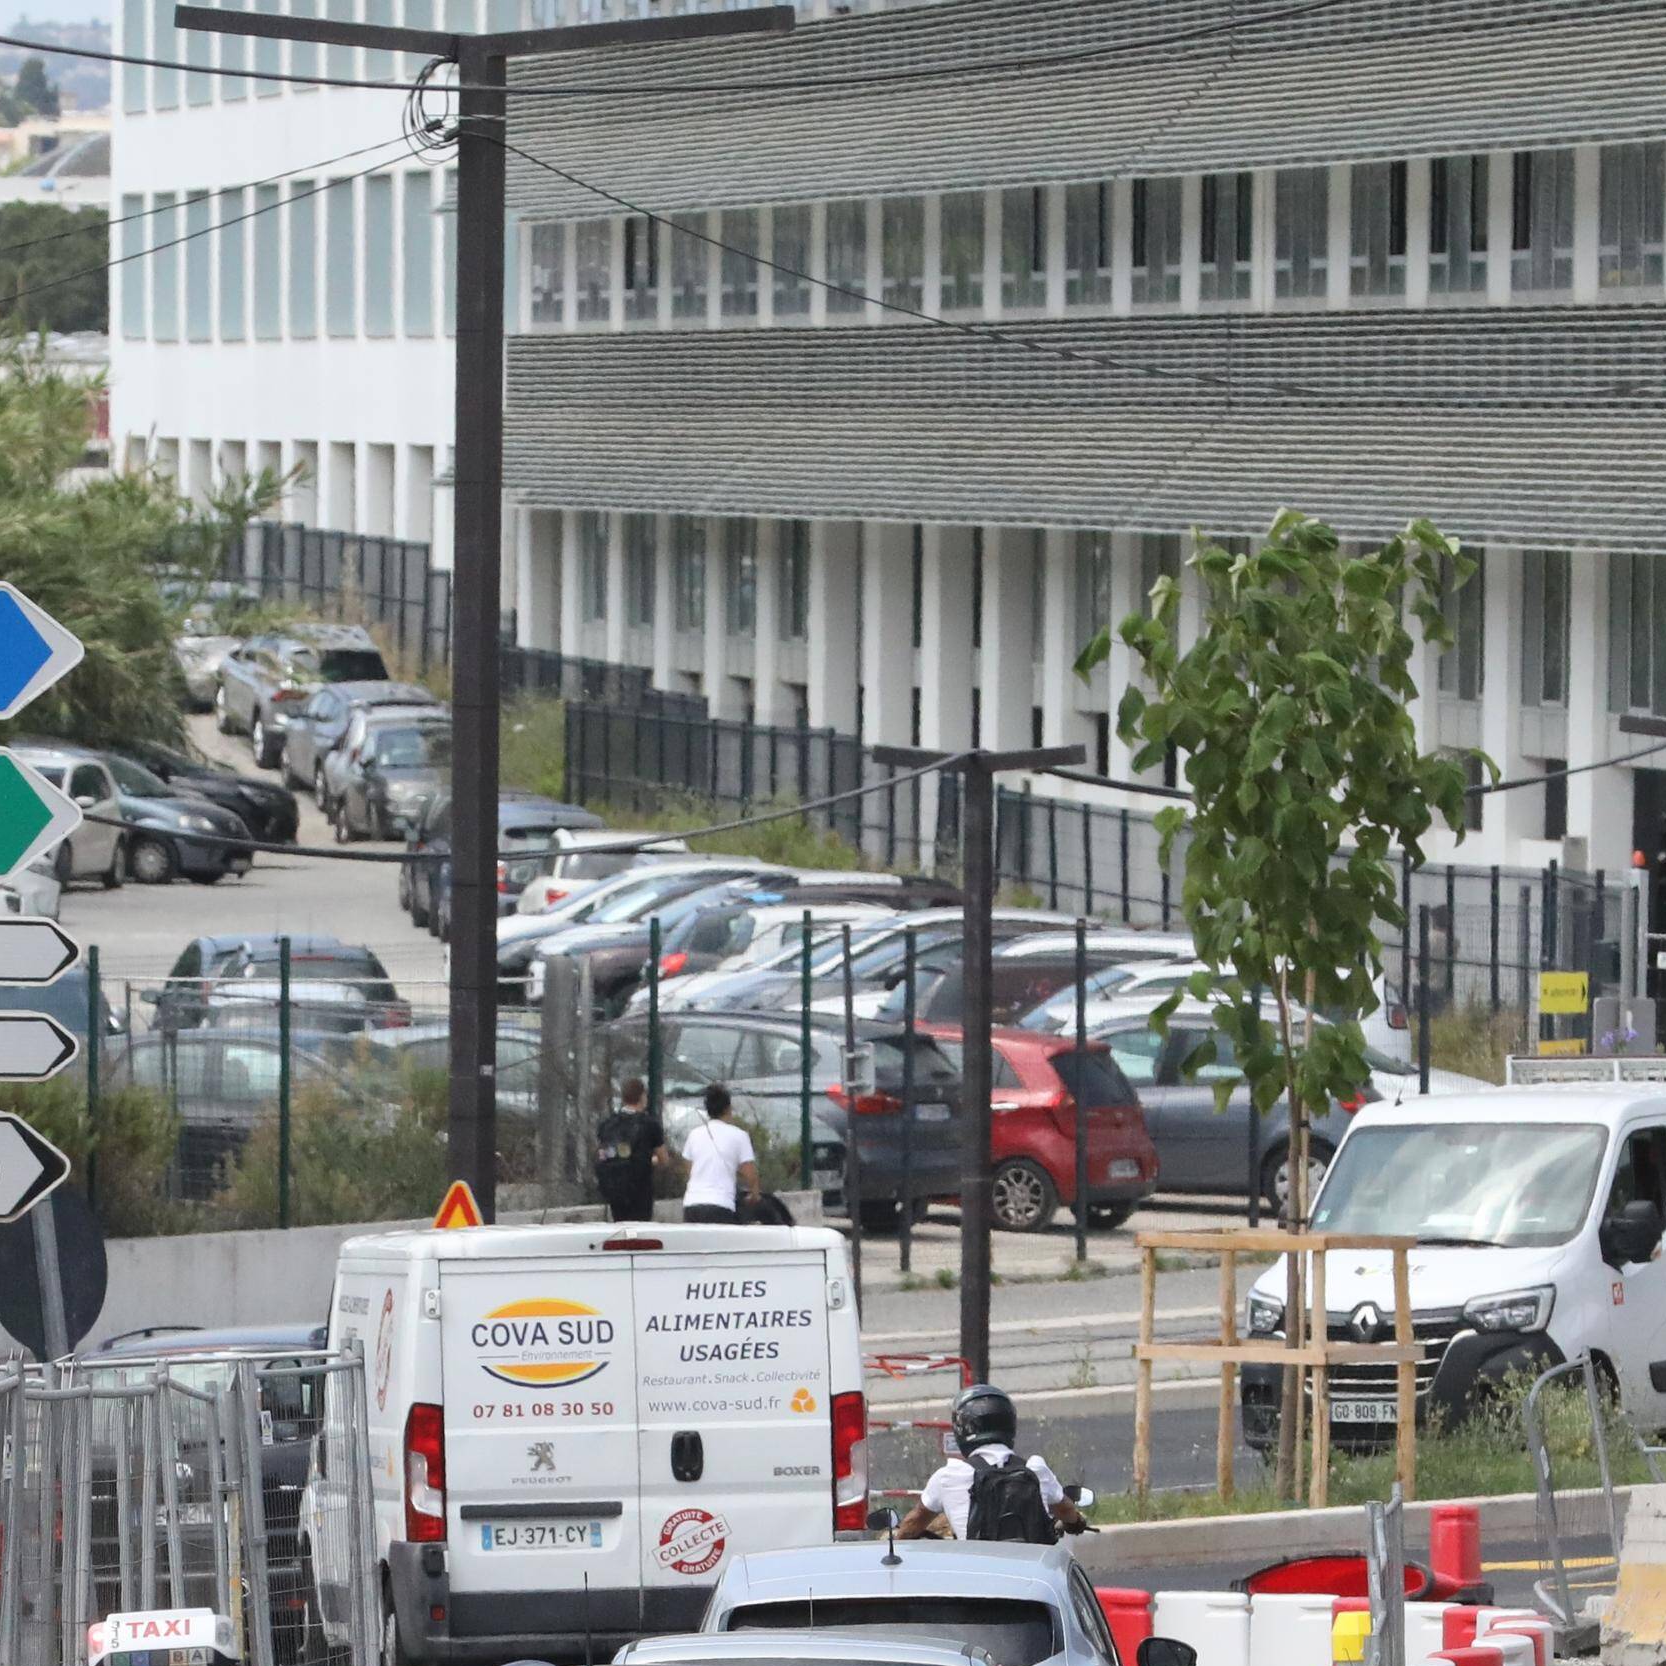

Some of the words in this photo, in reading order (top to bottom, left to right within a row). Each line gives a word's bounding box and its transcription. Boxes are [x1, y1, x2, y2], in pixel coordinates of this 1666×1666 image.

[686, 1280, 767, 1300] HUILES
[645, 1309, 812, 1333] ALIMENTAIRES
[471, 1321, 549, 1347] COVA
[558, 1319, 614, 1346] SUD
[521, 1350, 593, 1362] Environnement
[680, 1337, 780, 1362] USAGÉES
[473, 1405, 495, 1418] 07
[503, 1404, 524, 1417] 81
[532, 1403, 554, 1416] 08
[561, 1402, 583, 1416] 30
[591, 1402, 614, 1415] 50
[649, 1396, 781, 1413] www.cova-sud.fr
[511, 1476, 572, 1485] PEUGEOT
[773, 1466, 820, 1477] BOXER
[663, 1510, 703, 1535] GRATUITE
[495, 1525, 586, 1547] EJ-371-CY
[659, 1521, 725, 1562] COLLECTE
[682, 1547, 722, 1574] GRATUITE
[125, 1618, 190, 1640] TAXI
